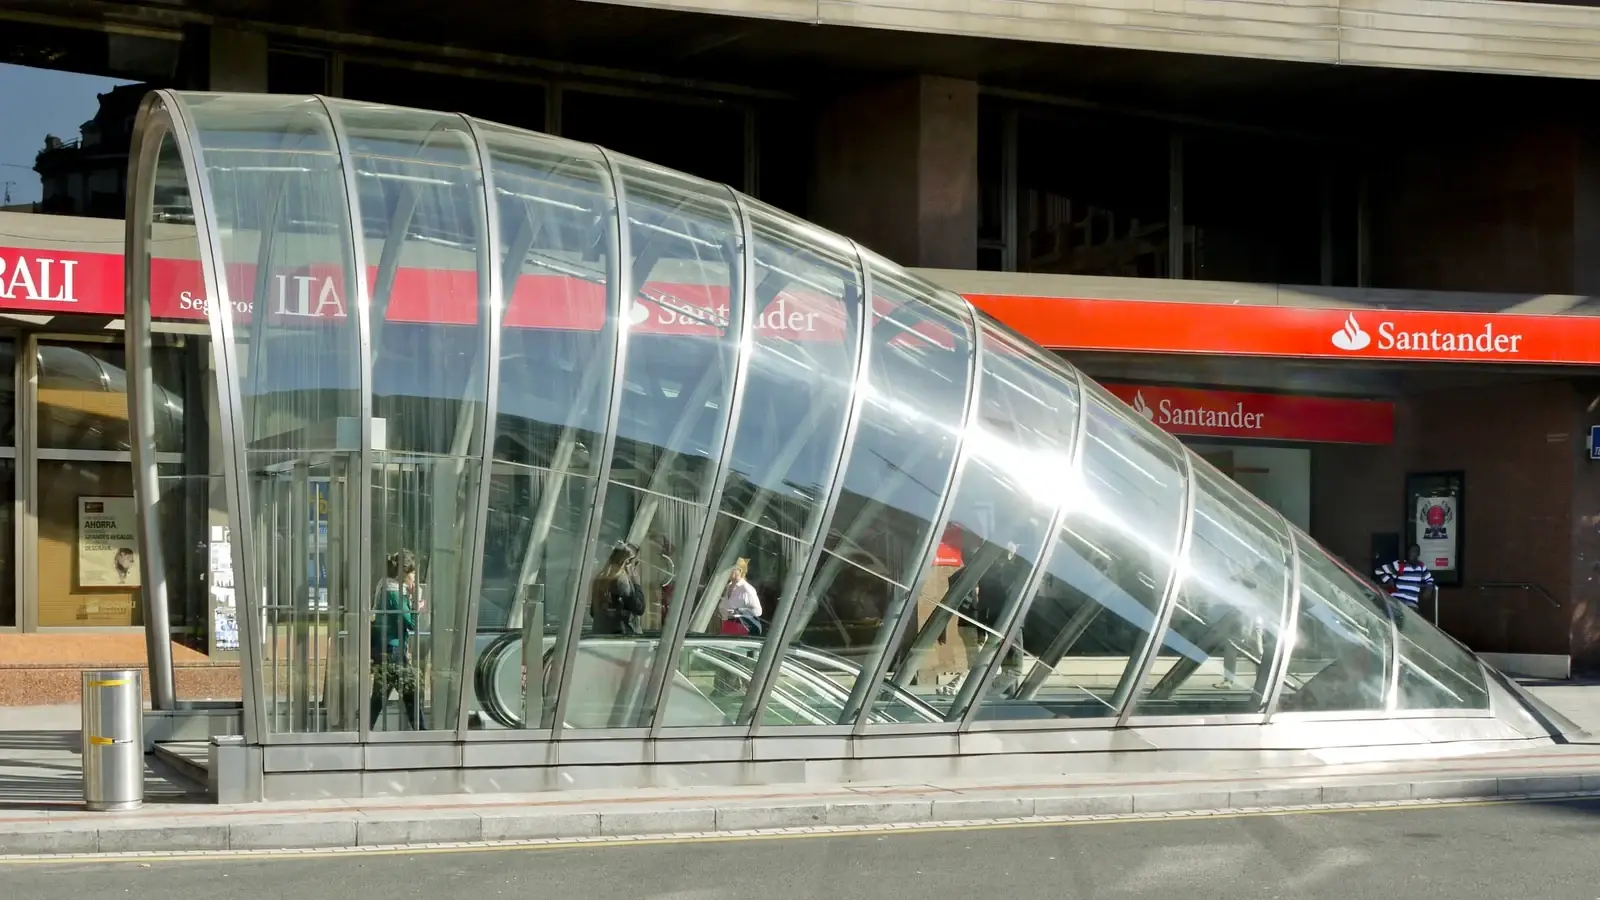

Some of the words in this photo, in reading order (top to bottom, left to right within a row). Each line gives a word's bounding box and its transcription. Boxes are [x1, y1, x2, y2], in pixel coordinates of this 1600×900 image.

[1378, 321, 1522, 353] Santander
[1159, 399, 1264, 429] Santander
[84, 520, 117, 529] AHORRA
